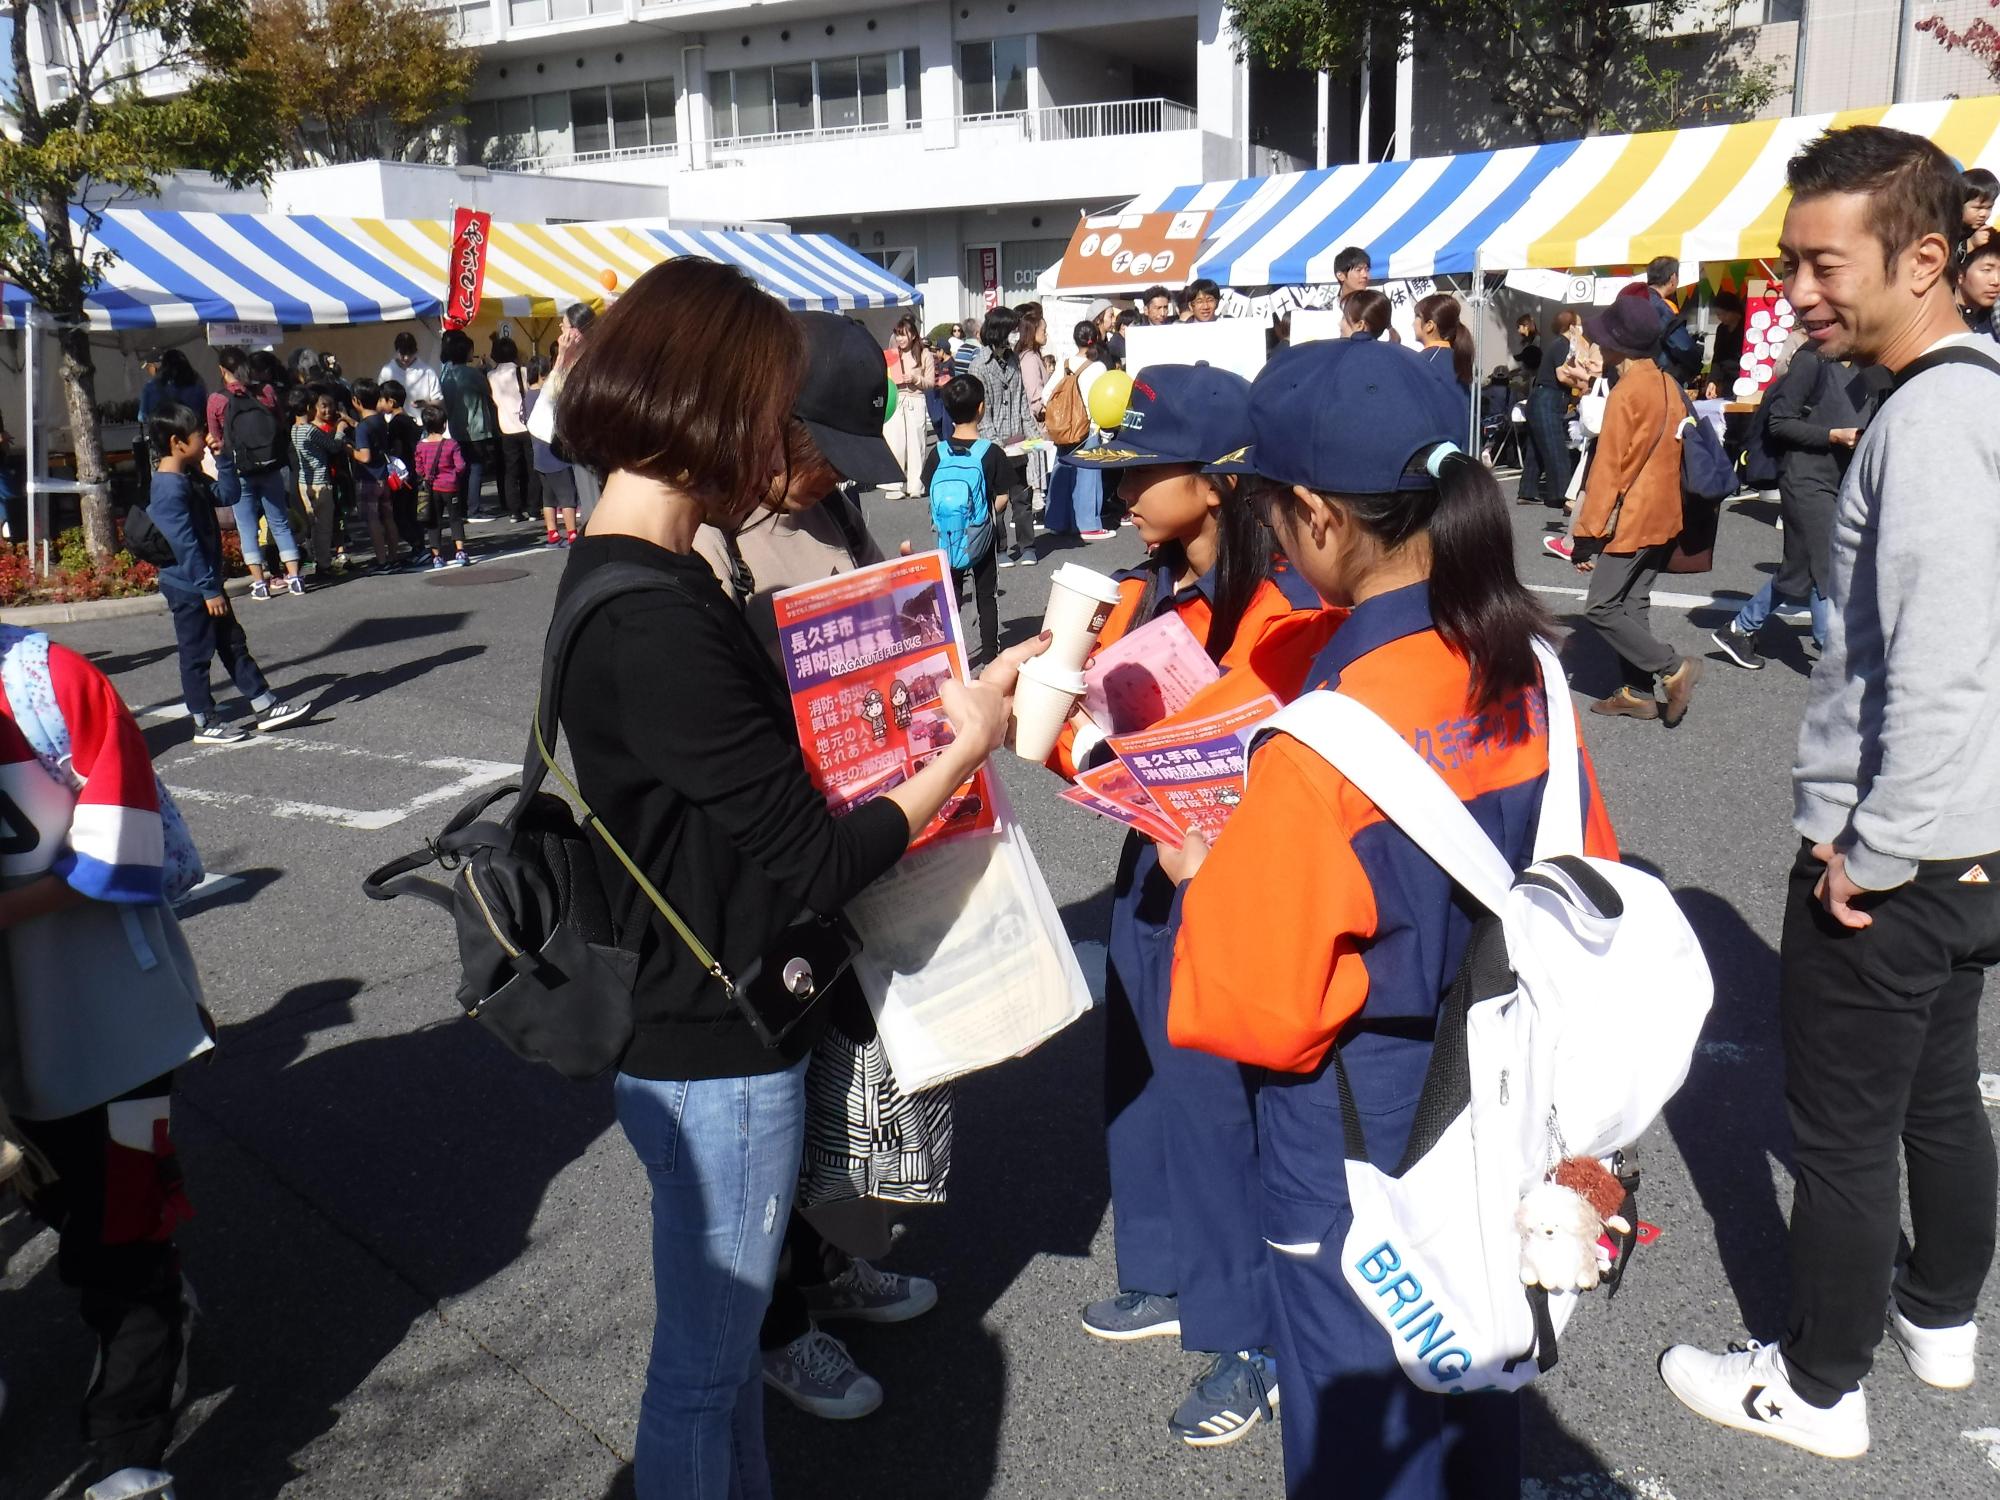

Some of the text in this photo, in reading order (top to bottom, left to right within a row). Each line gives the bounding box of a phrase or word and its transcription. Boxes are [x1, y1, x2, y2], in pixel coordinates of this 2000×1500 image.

[1014, 269, 1046, 284] COF
[1390, 276, 1432, 309] 体験
[790, 616, 854, 655] 長久手市
[795, 629, 894, 679] 消防団員募集
[829, 635, 921, 677] NAGAKUTE FIRE V.C
[816, 721, 871, 754] 地元の人
[1133, 748, 1202, 769] 長久手市
